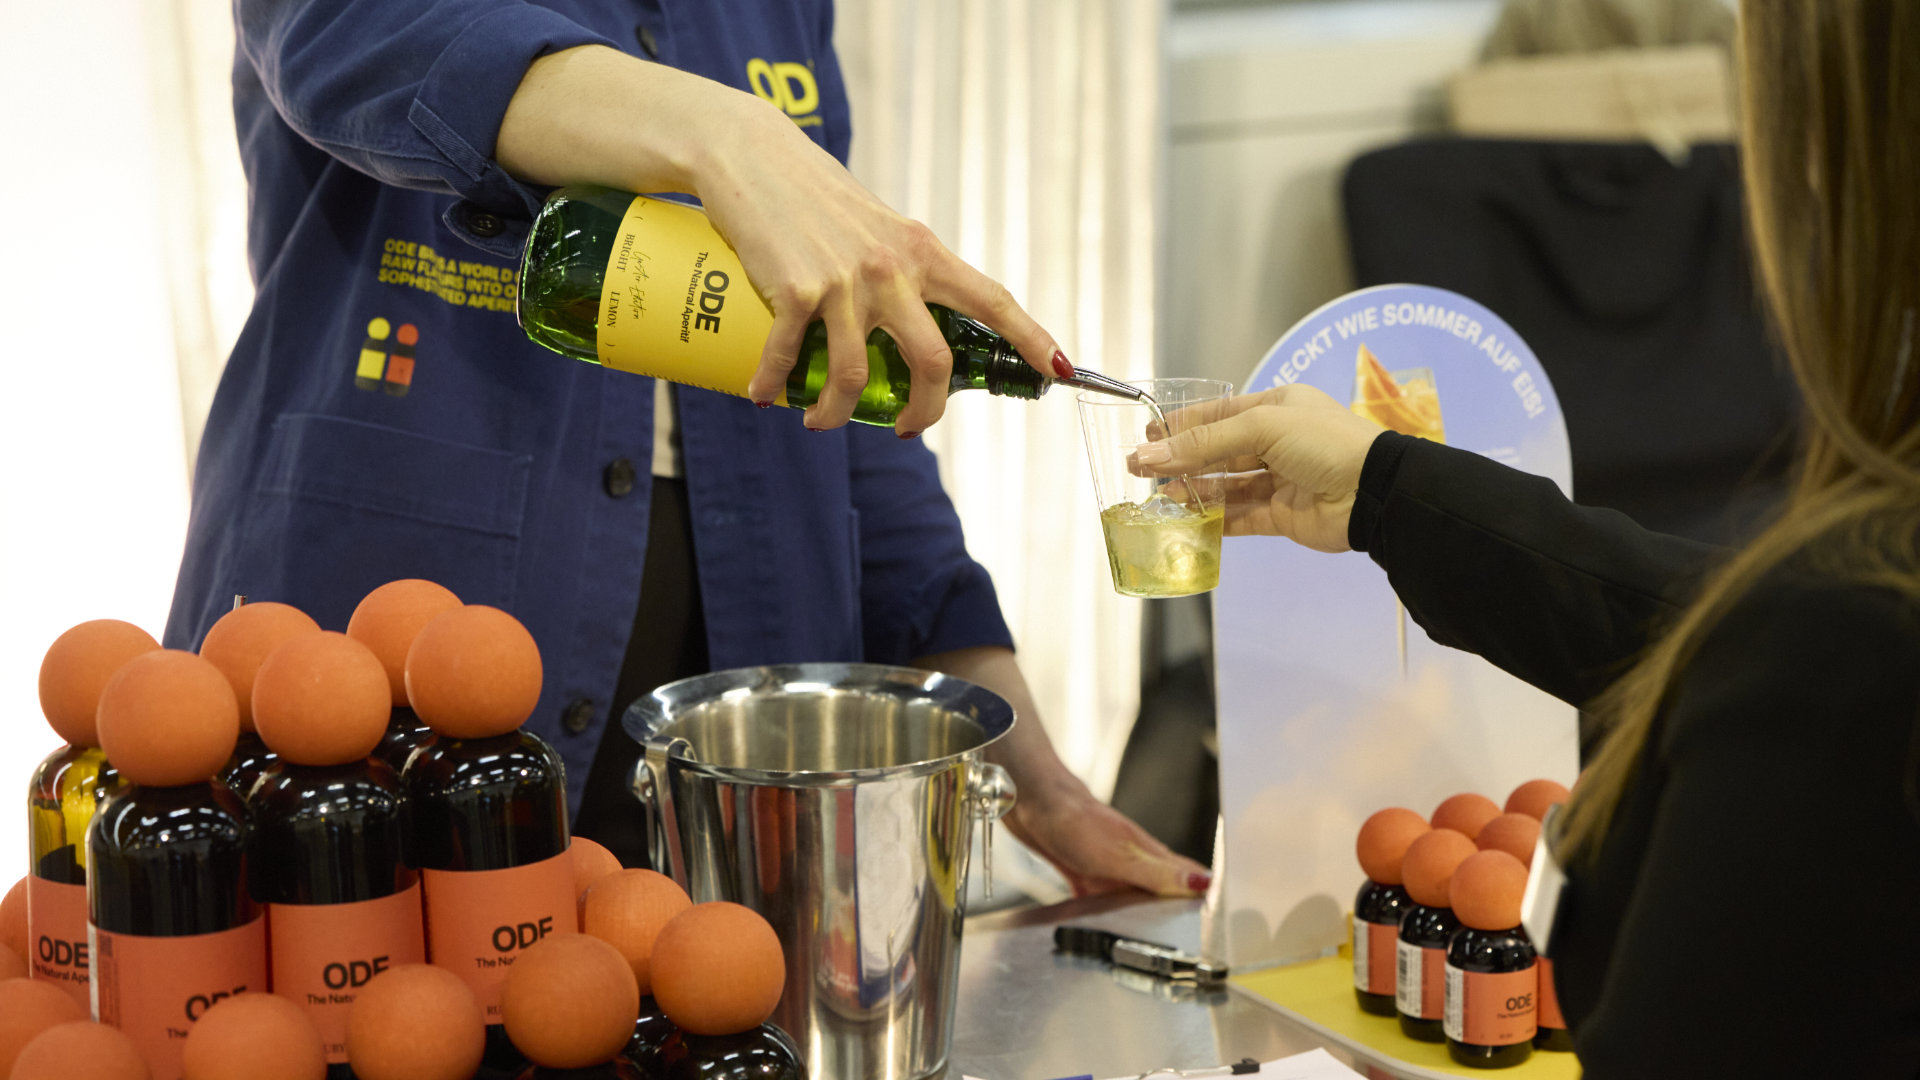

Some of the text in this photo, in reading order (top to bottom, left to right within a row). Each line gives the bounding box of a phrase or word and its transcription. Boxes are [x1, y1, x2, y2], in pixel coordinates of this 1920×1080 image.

[385, 238, 417, 257] ODE
[459, 260, 513, 283] WORLD
[616, 233, 635, 273] BRIGHT
[381, 252, 417, 271] RAW
[466, 278, 503, 297] INTO
[467, 293, 517, 313] APERIT
[606, 291, 621, 328] LEMON
[679, 251, 709, 343] The Natural Aperitif
[694, 270, 730, 334] ODE
[1334, 306, 1379, 340] WIE
[1382, 301, 1483, 346] SOMMER
[1479, 333, 1522, 373] AUF
[1512, 370, 1546, 419] EIS!
[39, 935, 89, 968] ODE
[475, 957, 496, 968] The
[41, 965, 70, 981] Natural
[306, 993, 327, 1005] The
